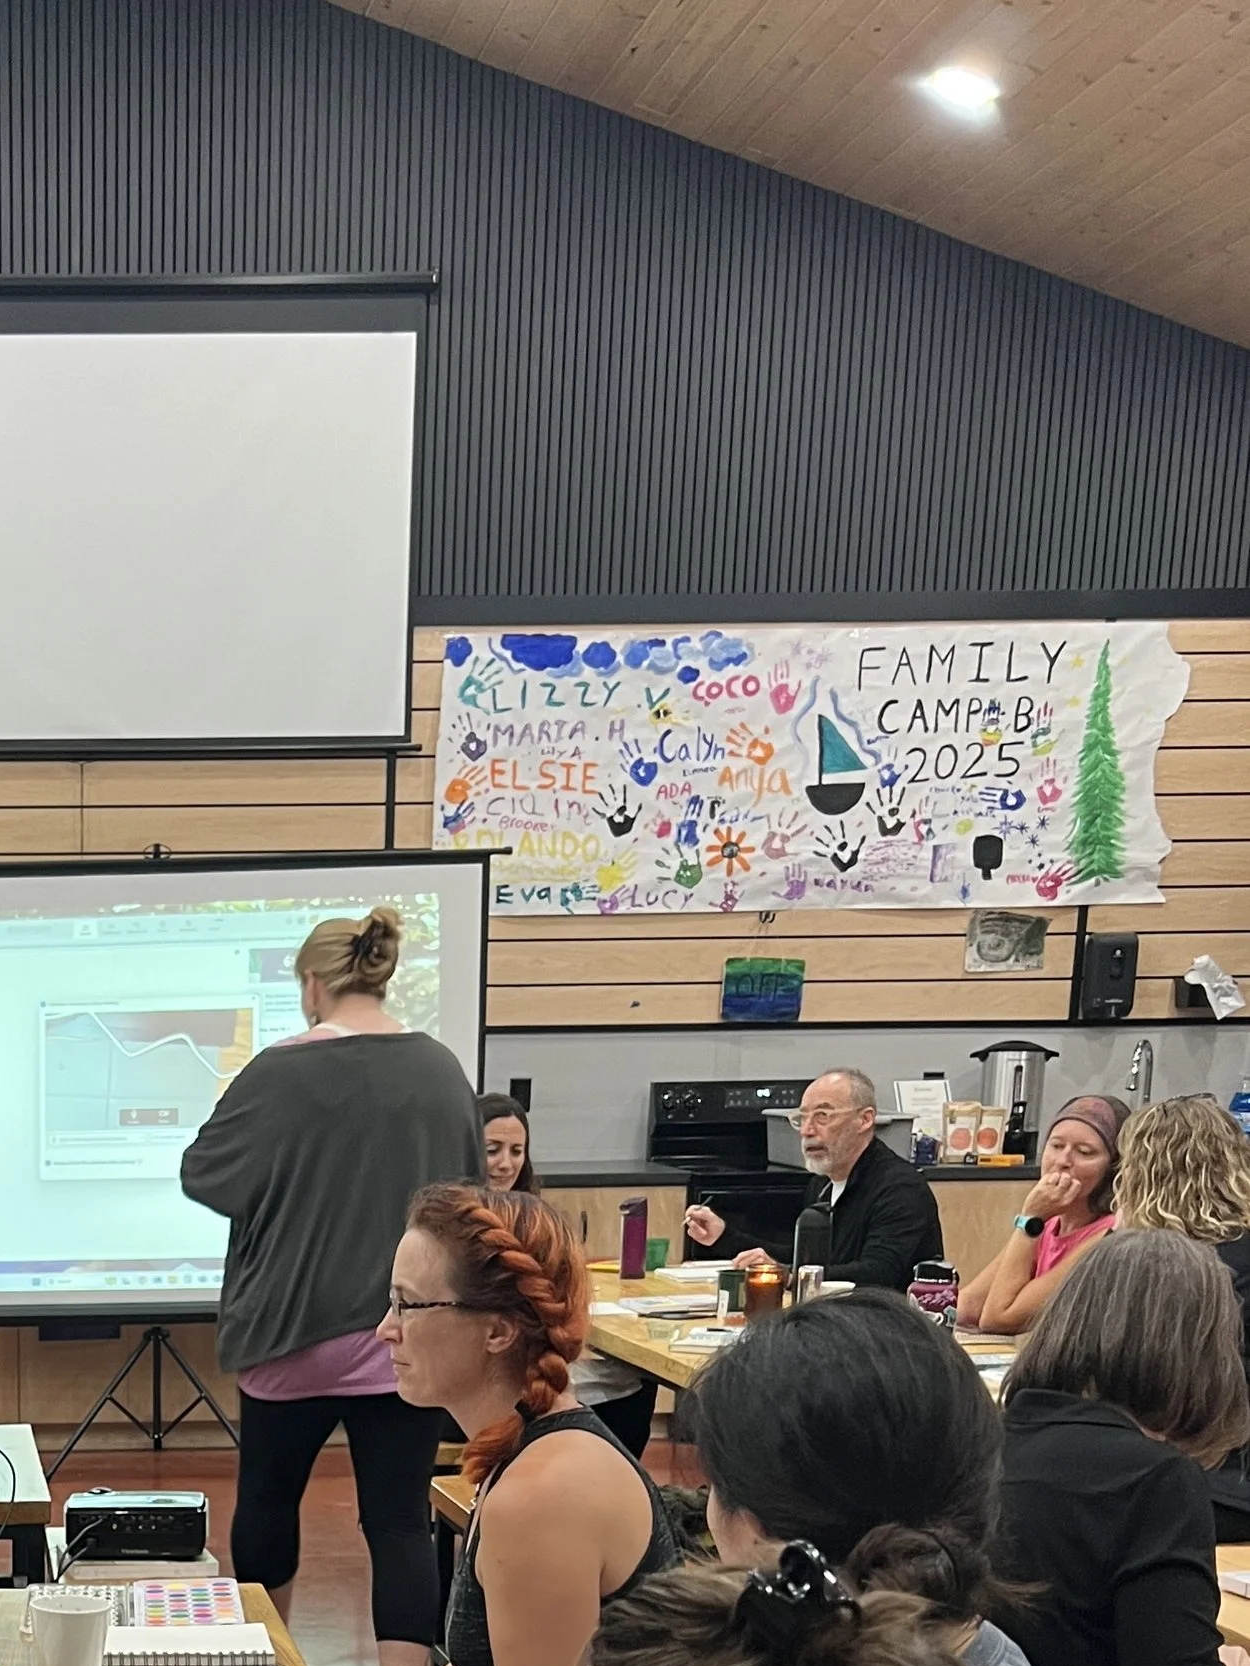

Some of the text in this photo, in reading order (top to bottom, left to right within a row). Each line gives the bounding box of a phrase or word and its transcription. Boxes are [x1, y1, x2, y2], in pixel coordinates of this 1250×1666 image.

[857, 640, 1067, 691] FAMILY
[490, 680, 622, 713] LIZZY
[691, 674, 761, 702] COCO
[492, 719, 586, 748] MARIA
[877, 698, 984, 734] CAMP
[490, 758, 600, 794] ELSIE
[905, 741, 1025, 783] 2025
[656, 781, 692, 800] ADA
[717, 766, 793, 807] Anya
